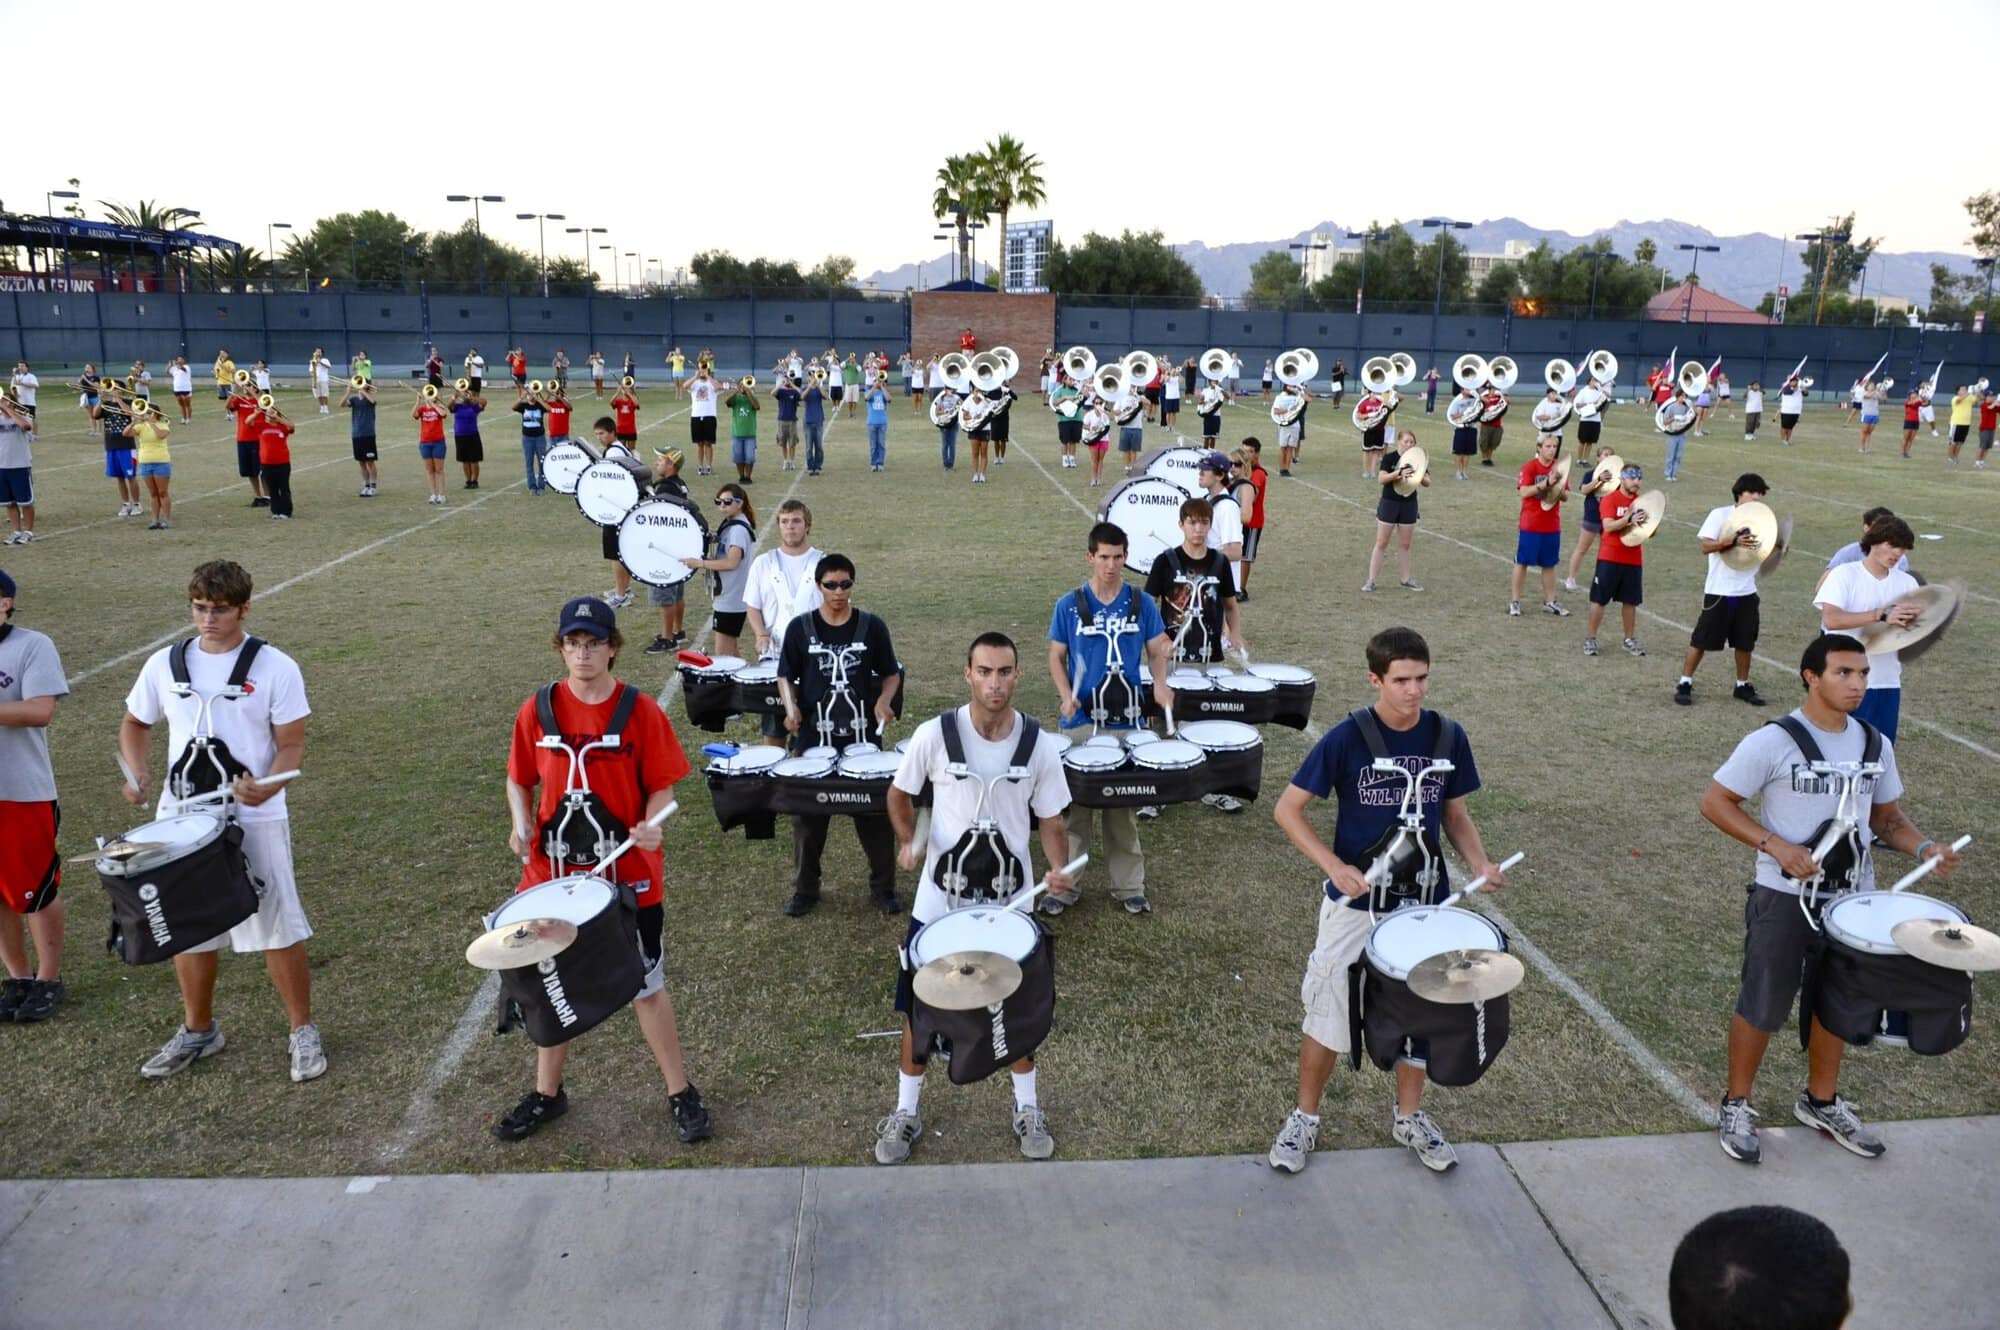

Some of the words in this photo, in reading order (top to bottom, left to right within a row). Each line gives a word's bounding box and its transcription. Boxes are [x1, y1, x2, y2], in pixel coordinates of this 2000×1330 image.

[70, 227, 79, 236] OF
[88, 228, 117, 239] ARIZONA
[557, 453, 582, 461] YAMAHA
[1175, 460, 1201, 470] YAMA
[599, 472, 626, 481] YAMAHA
[1140, 494, 1180, 506] YAMAHA
[648, 515, 689, 529] YAMAHA
[1210, 702, 1245, 712] YAMAHA
[1115, 786, 1157, 796] YAMAHA
[828, 793, 871, 803] YAMAHA
[144, 898, 172, 947] YAMAHA
[543, 971, 578, 1028] YAMAHA
[991, 1009, 1009, 1060] YAMAHA
